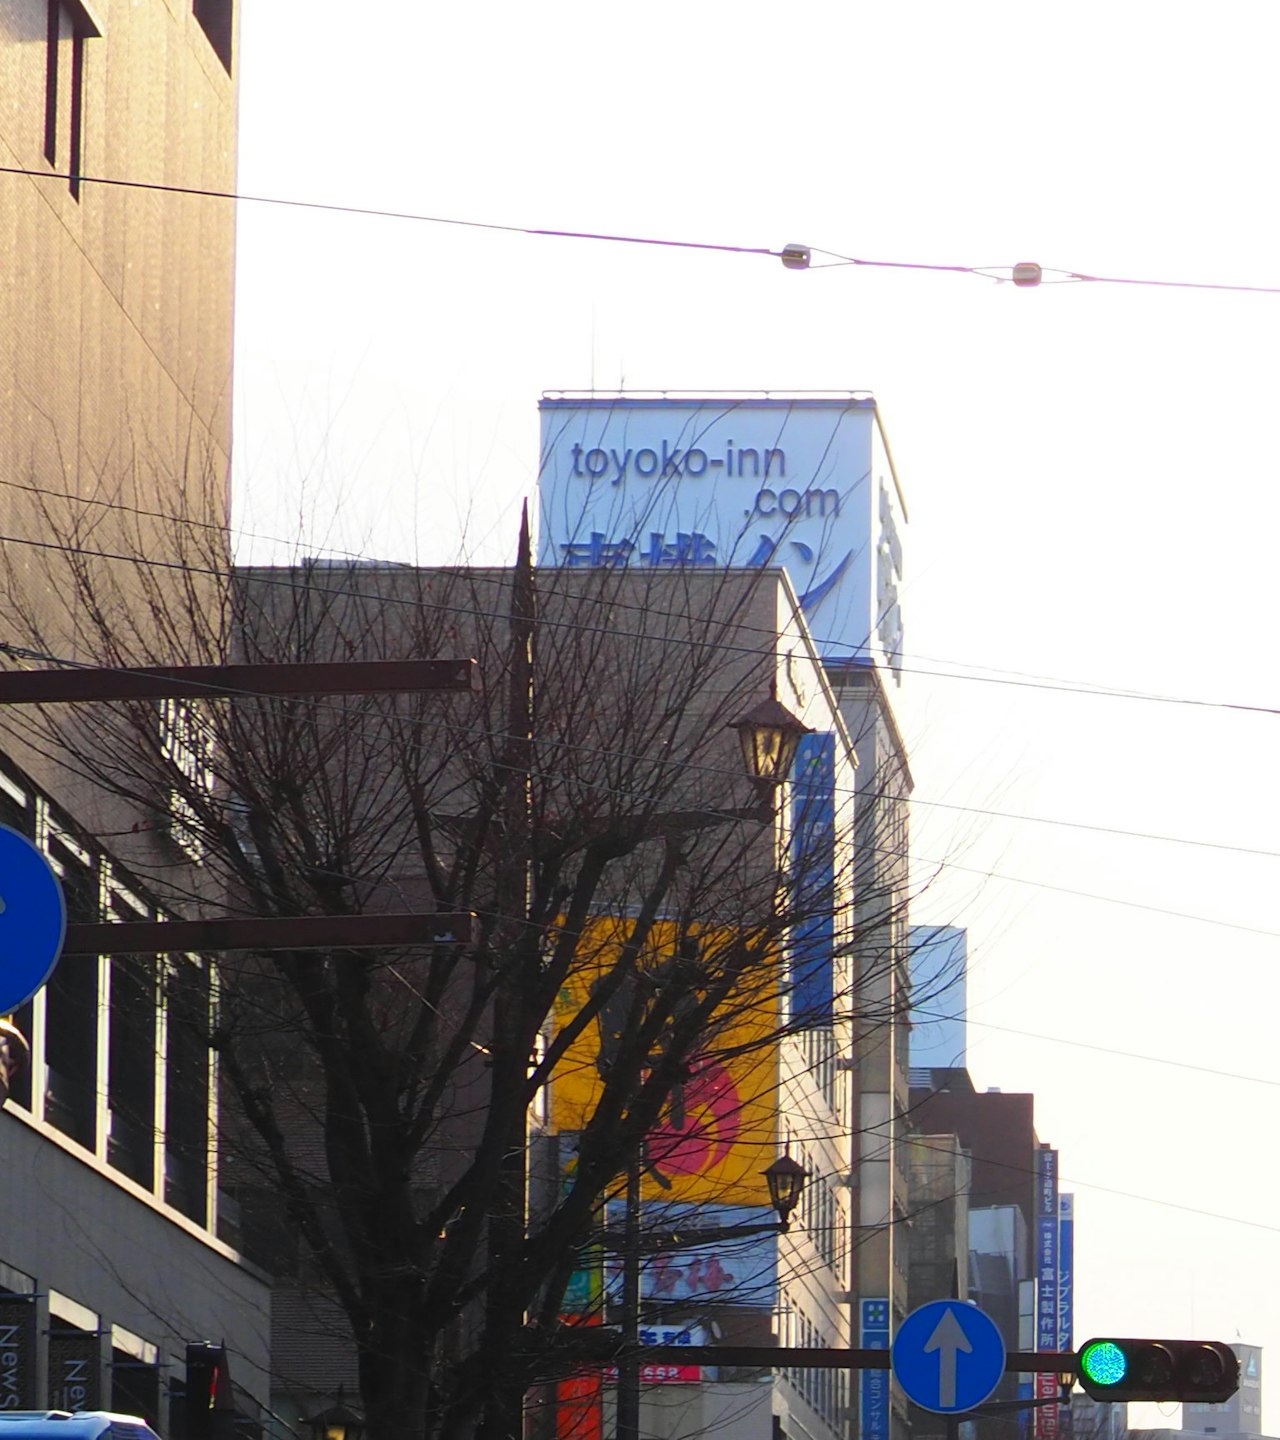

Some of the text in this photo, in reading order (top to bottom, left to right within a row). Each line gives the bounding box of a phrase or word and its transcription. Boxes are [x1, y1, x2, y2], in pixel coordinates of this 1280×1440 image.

[571, 440, 786, 486] toyoko-inn
[744, 489, 840, 518] .com
[1040, 1268, 1055, 1346] 富士製作所
[1057, 1271, 1072, 1352] ジブラルタ
